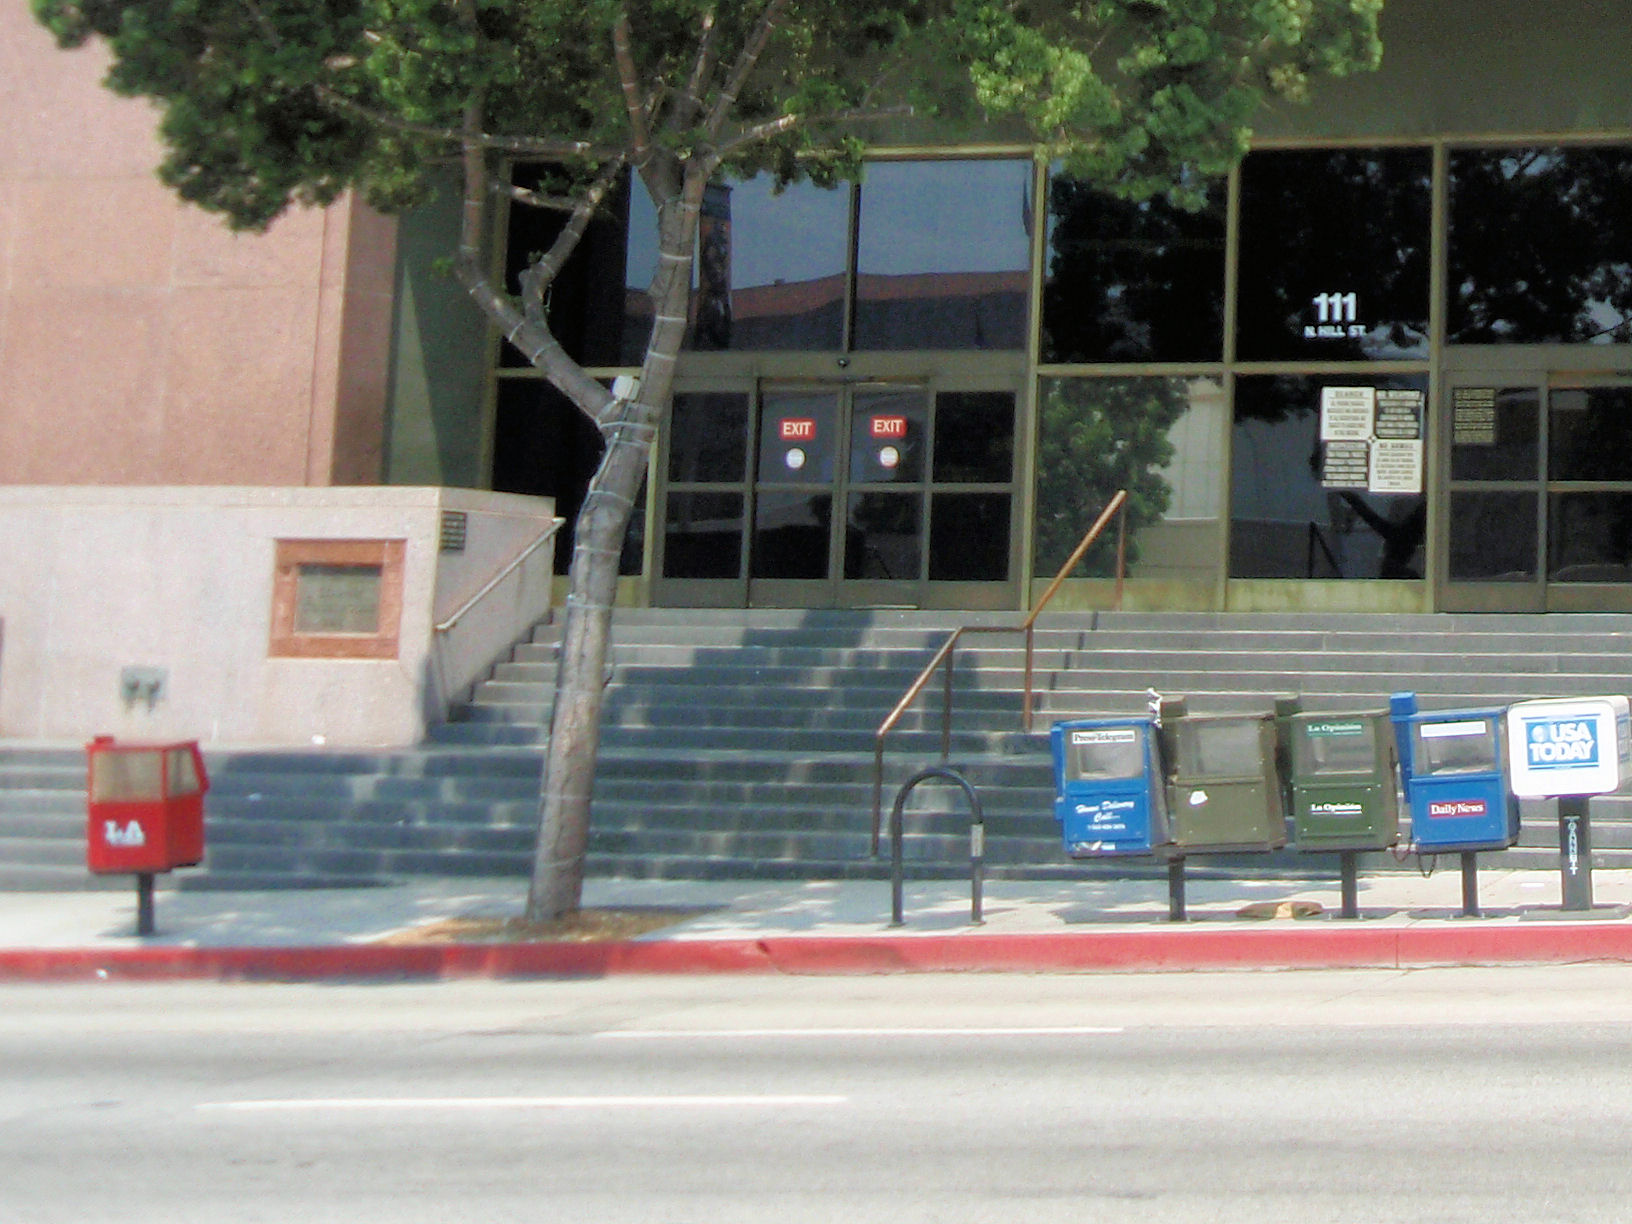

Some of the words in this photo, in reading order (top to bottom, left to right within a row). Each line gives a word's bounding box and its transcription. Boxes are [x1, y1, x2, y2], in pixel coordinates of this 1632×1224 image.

[1312, 292, 1356, 323] 111
[782, 422, 811, 436] EXIT
[874, 419, 903, 433] EXIT
[1551, 722, 1592, 741] USA
[1529, 740, 1595, 762] TODAY
[1431, 804, 1456, 815] Daily
[1457, 803, 1484, 813] News
